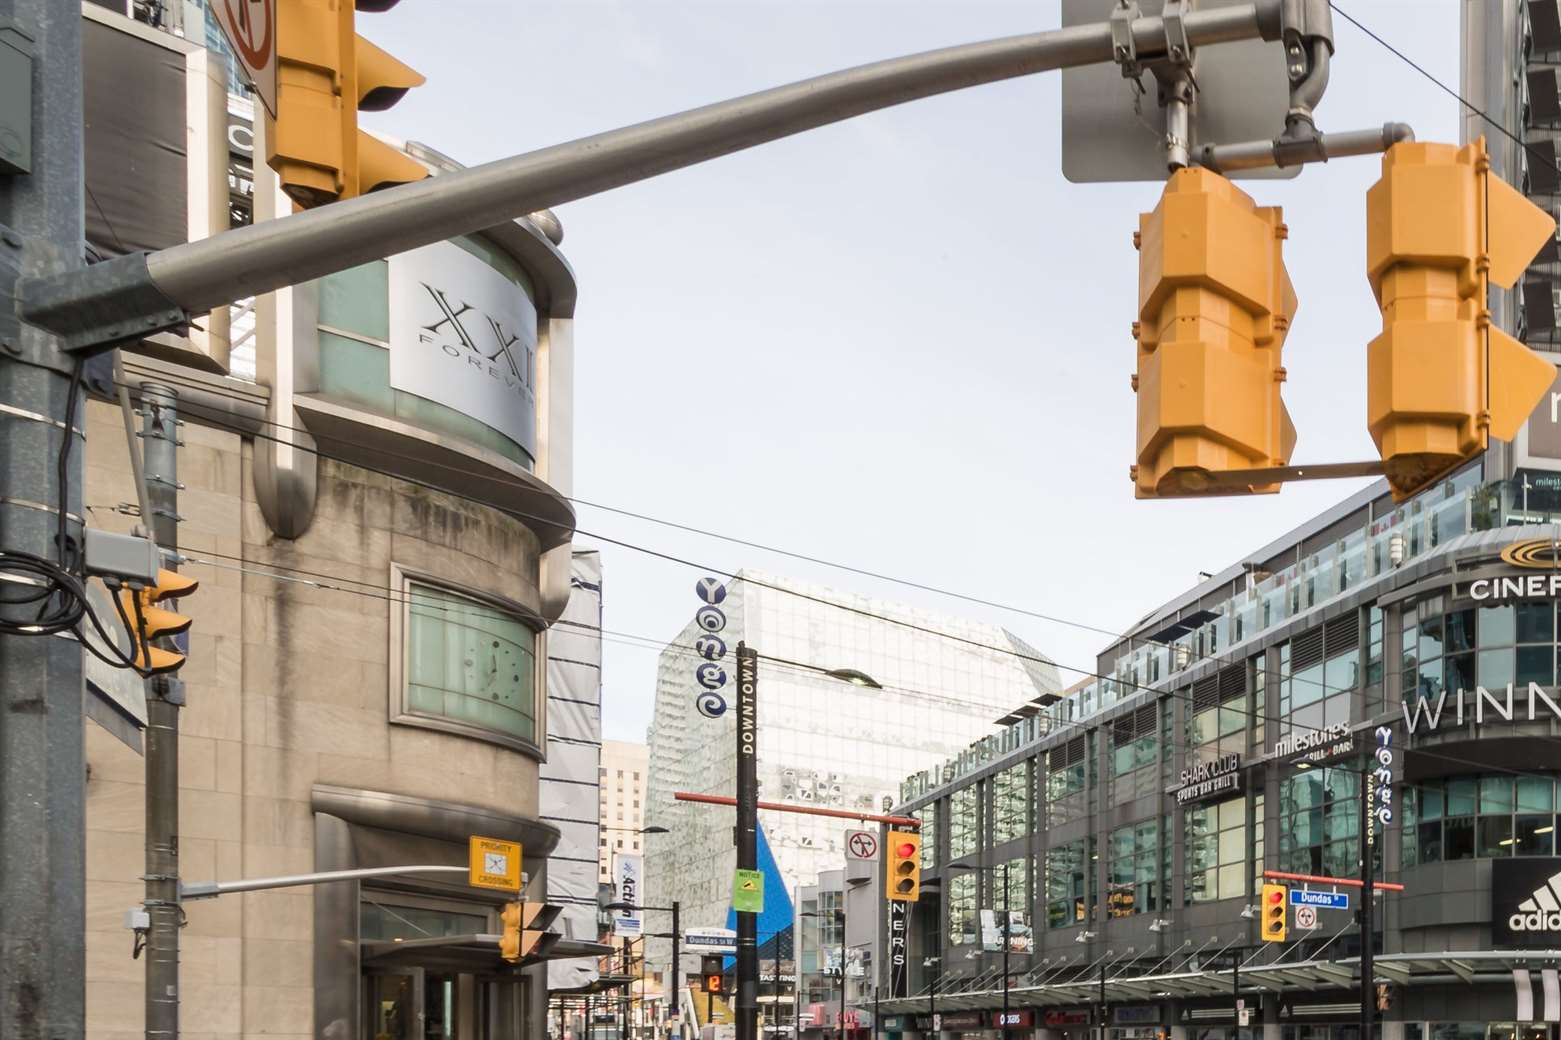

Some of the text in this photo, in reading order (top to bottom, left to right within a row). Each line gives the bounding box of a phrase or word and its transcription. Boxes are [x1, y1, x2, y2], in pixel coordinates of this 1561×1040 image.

[742, 656, 753, 755] DOWNTOWN
[1274, 720, 1350, 758] milestones
[1180, 754, 1238, 787] SHARK CLUB
[480, 841, 512, 853] PRIORITY
[478, 876, 514, 888] CROSSING
[738, 871, 760, 879] NOTICE
[622, 875, 635, 918] Actin
[1301, 892, 1332, 905] Dundas
[689, 936, 719, 945] Dundas
[892, 903, 905, 965] NERS
